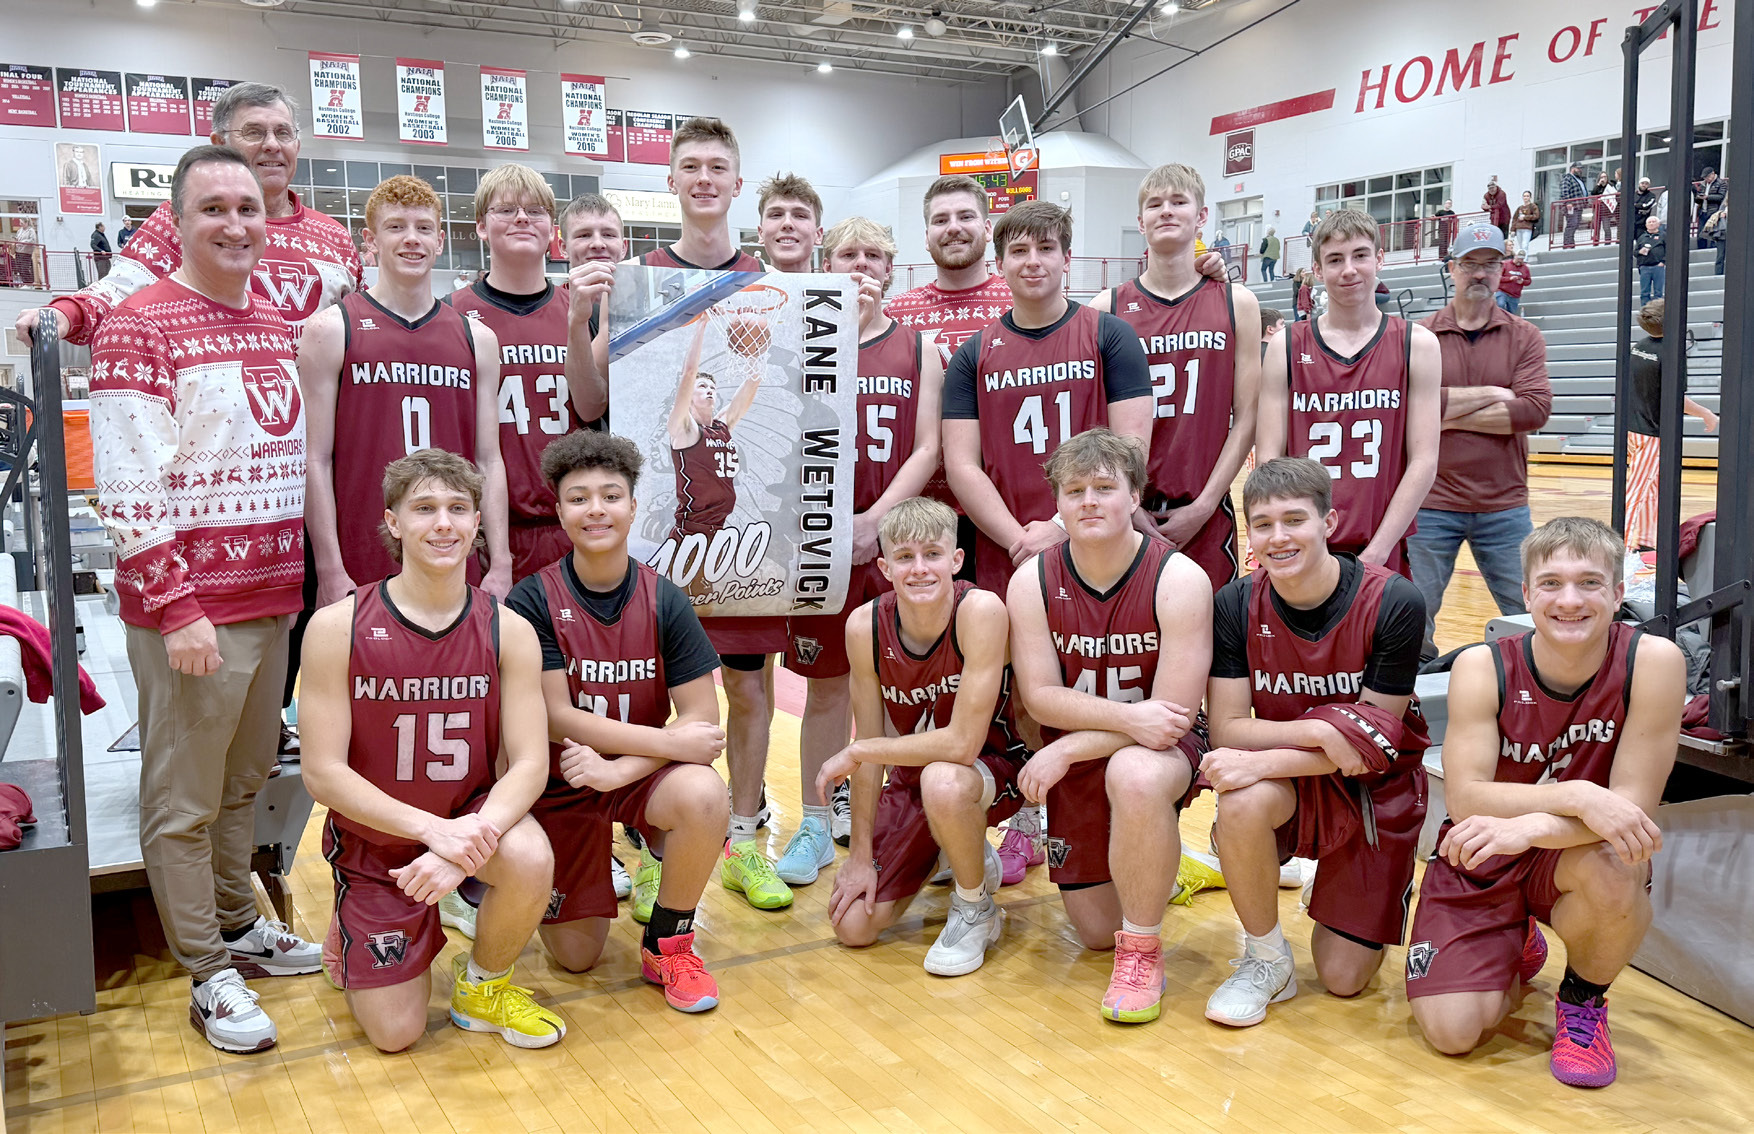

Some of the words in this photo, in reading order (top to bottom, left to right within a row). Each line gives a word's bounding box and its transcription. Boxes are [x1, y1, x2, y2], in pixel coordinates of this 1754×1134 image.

[1354, 32, 1519, 113] HOME
[1547, 17, 1607, 64] OF
[71, 76, 107, 84] NATIONAL
[314, 71, 356, 80] NATIONAL
[64, 81, 115, 89] TOURNAMENT
[314, 78, 356, 90] CHAMPIONS
[401, 78, 441, 87] NATIONAL
[63, 86, 117, 94] APPEARANCES
[131, 91, 183, 99] APPEARANCES
[132, 86, 182, 94] TOURNAMENT
[401, 85, 442, 96] CHAMPIONS
[485, 85, 523, 94] NATIONAL
[485, 92, 523, 103] CHAMPIONS
[566, 92, 602, 101] NATIONAL
[566, 100, 602, 110] CHAMPIONS
[316, 118, 359, 126] BASKETBALL
[327, 124, 350, 134] 2002
[412, 128, 435, 139] 2003
[496, 136, 517, 146] 2006
[577, 142, 595, 151] 2016
[1229, 146, 1251, 159] GPAC
[625, 196, 650, 209] Mary
[803, 288, 843, 395] KANE
[500, 344, 567, 364] RRIOR
[351, 362, 471, 390] WARRIORS
[984, 360, 1096, 393] WARRIORS
[1149, 358, 1200, 419] 21
[498, 374, 570, 435] 43
[1293, 388, 1401, 413] WARRIORS
[401, 396, 431, 456] 0
[1012, 390, 1072, 455] 41
[250, 438, 302, 459] WARRIORS
[1308, 419, 1382, 480] 23
[714, 452, 740, 478] 35
[791, 427, 841, 611] WETOVICK
[646, 521, 771, 588] 1000
[719, 578, 785, 605] Points
[1052, 631, 1158, 658] WARRIORS
[392, 710, 471, 782] 15
